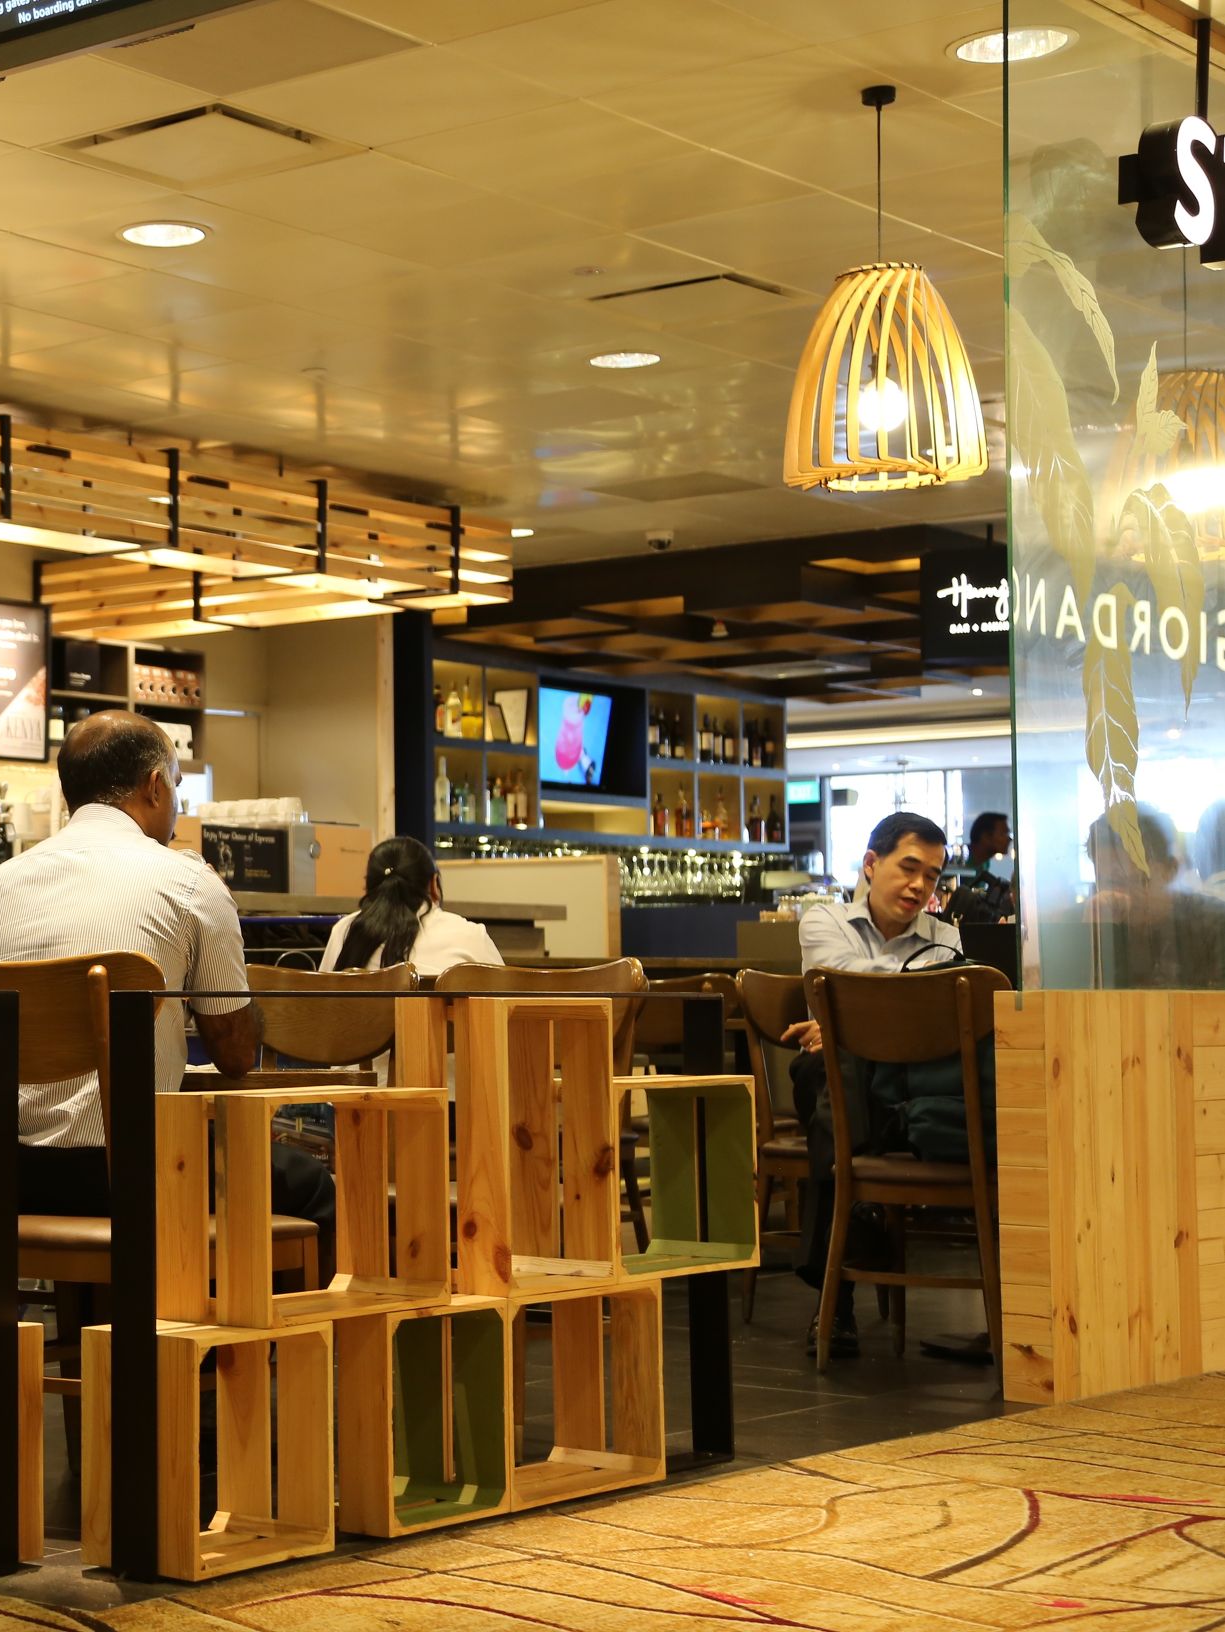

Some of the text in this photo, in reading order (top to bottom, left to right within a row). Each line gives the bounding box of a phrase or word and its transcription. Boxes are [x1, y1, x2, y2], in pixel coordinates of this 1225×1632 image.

[18, 11, 32, 24] No
[33, 1, 75, 20] boarding
[1174, 115, 1225, 246] S
[6, 715, 43, 741] KENYA
